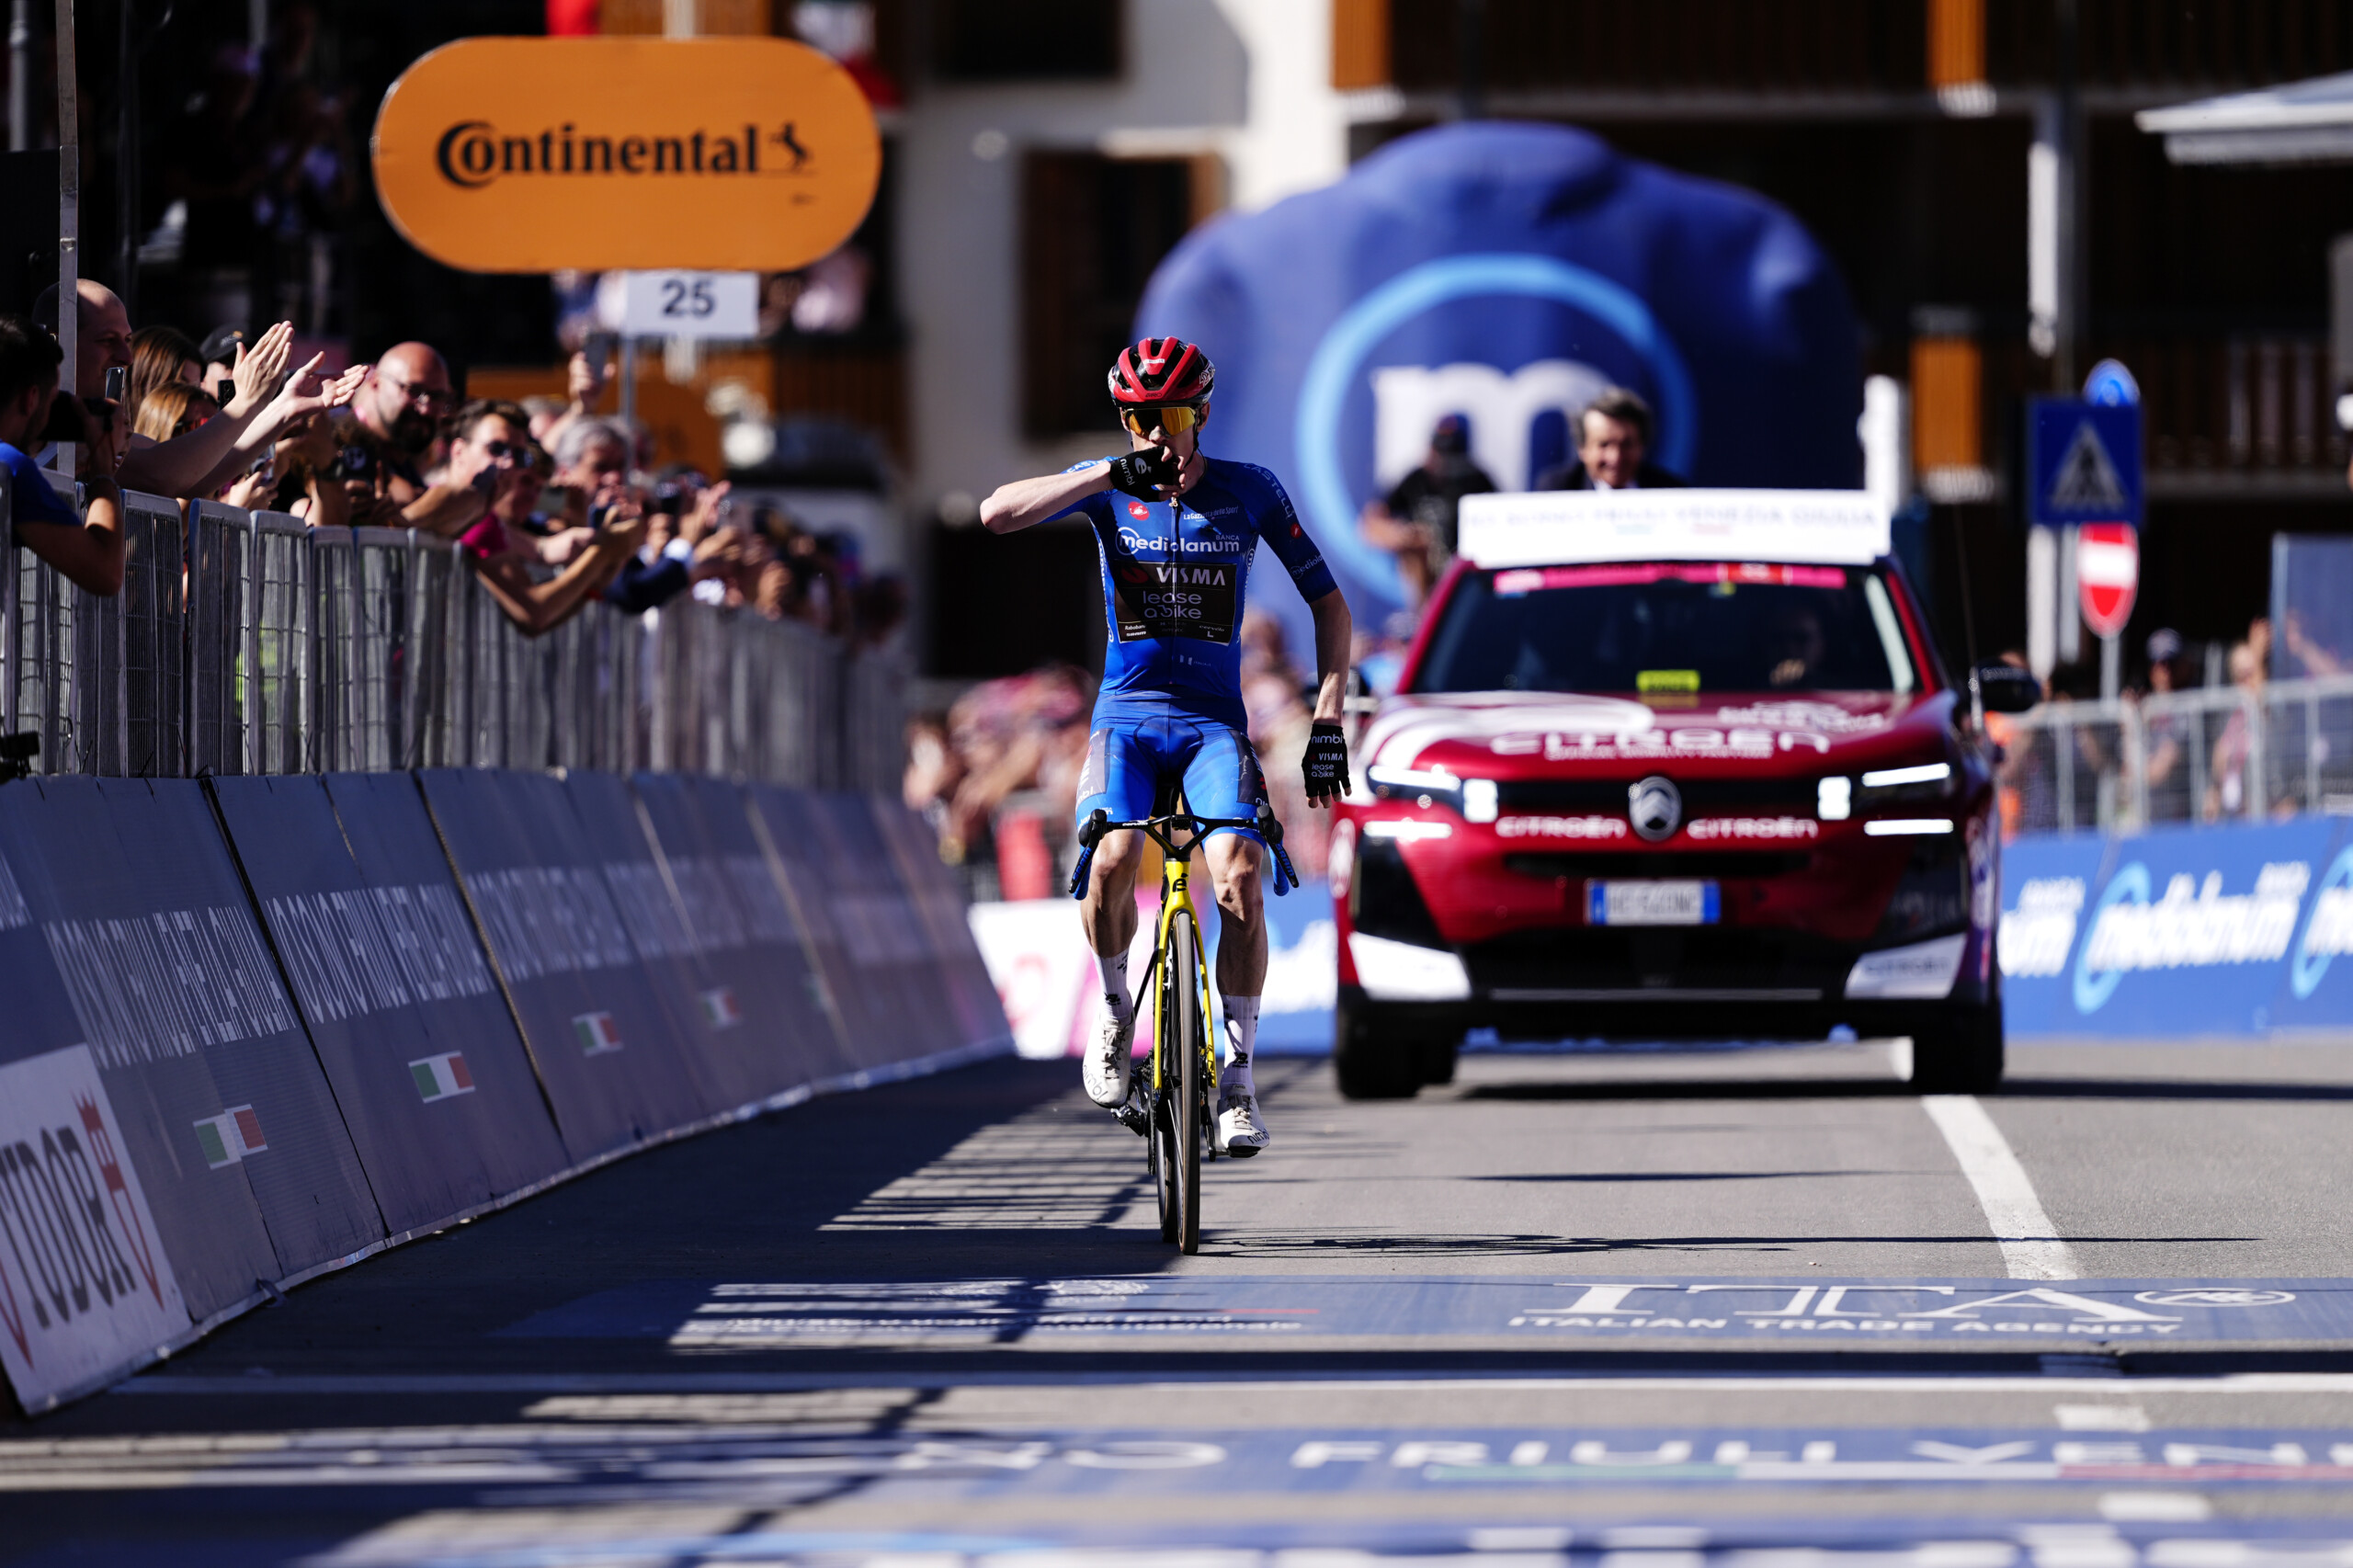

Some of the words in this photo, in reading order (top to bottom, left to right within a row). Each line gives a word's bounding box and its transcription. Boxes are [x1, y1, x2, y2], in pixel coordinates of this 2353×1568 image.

[436, 120, 759, 189] Continental
[661, 278, 716, 318] 25
[1120, 458, 1136, 486] nimbl
[1244, 462, 1296, 519] CASTELLI
[1119, 534, 1239, 552] mediolanum
[1156, 567, 1226, 586] VISMA
[1290, 553, 1324, 577] mediola
[1142, 591, 1202, 604] lease
[1311, 733, 1343, 744] nimbl
[1318, 753, 1344, 761] VISMA
[208, 900, 296, 1040] GIULIA
[1083, 1063, 1108, 1101] nimbl
[1506, 1316, 1729, 1329] ITALIAN
[1745, 1319, 1936, 1331] TRADE
[1952, 1322, 2182, 1335] AGENCY
